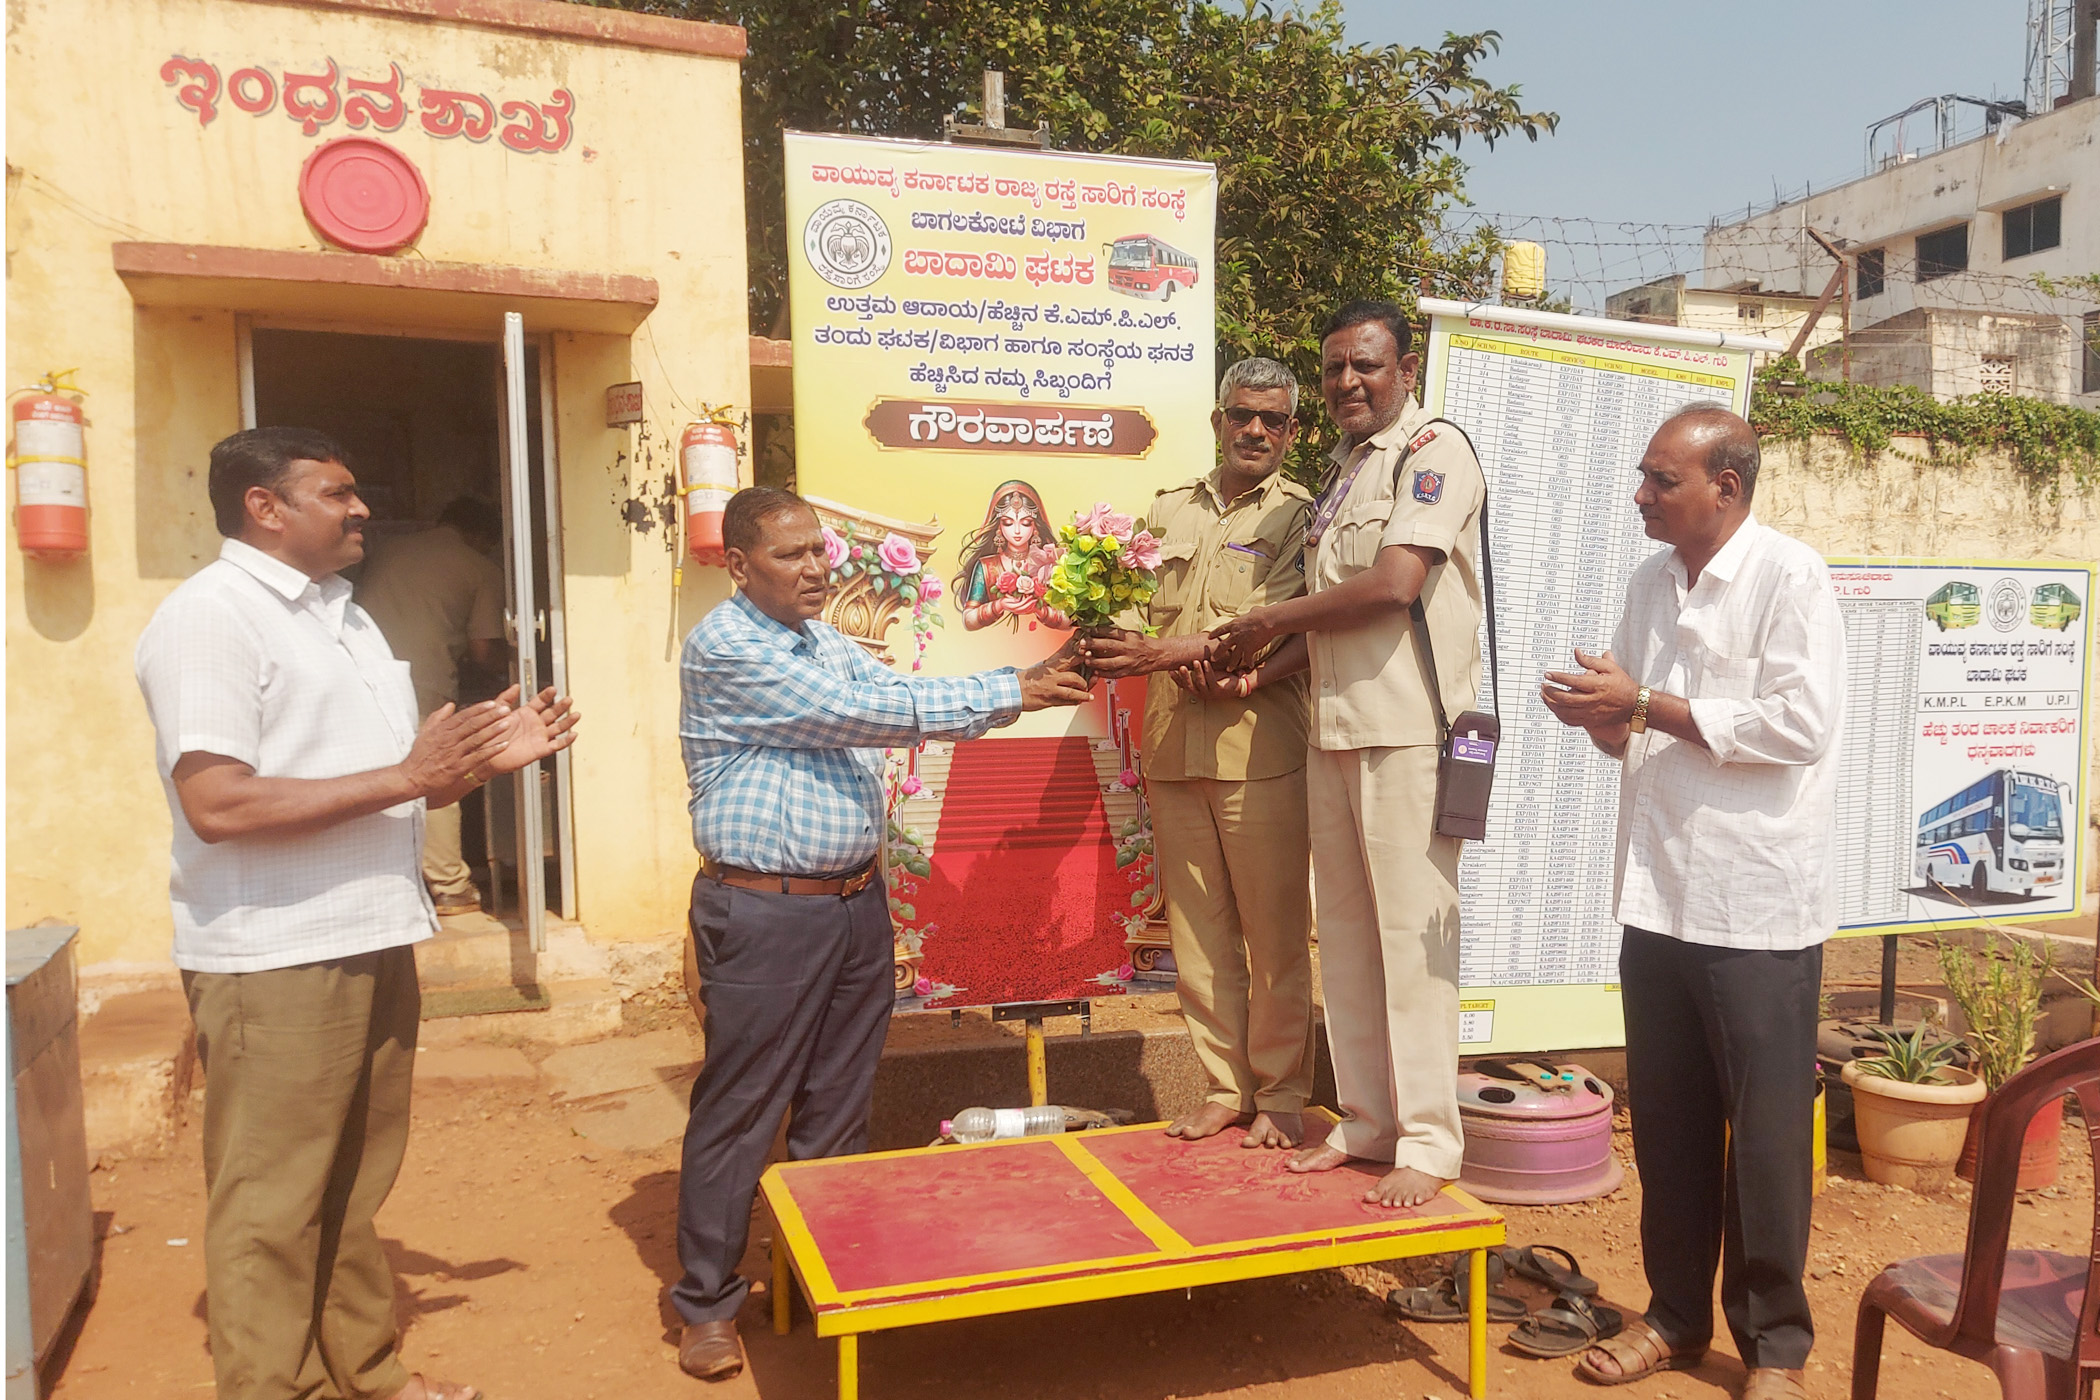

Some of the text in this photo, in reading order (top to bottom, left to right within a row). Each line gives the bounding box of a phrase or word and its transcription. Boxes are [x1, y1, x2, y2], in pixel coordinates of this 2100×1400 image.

[160, 55, 574, 153] ಇಂಧನ ಶಾಖೆ
[812, 163, 1186, 222] ವಾಯುವ್ಯ ಕರ್ನಾಟಕ ರಾಜ್ಯ ರಸ್ತೆ ಸಾರಿಗೆ ಸಂಸ್ಥೆ
[911, 209, 1086, 242] ಬಾಗಲಕೋಟೆ ವಿಭಾಗ
[904, 249, 1094, 288] ಬಾದಾಮಿ ಘಟಕ
[827, 294, 896, 320] ಉತ್ತಮ
[903, 299, 1038, 331] ಆದಾಯ/ಹೆಚ್ಚಿನ
[815, 325, 1195, 370] ತಂದು ಘಟಕ/ವಿಭಾಗ ಹಾಗೂ ಸಂಸ್ಥೆಯ ಘನತೆ
[1540, 328, 1572, 342] ಬಾದಾಮಿ
[1577, 334, 1604, 347] ಘಟಕದ
[1713, 356, 1728, 367] ಗುರಿ
[909, 362, 1112, 398] ಹೆಚ್ಚಿಸಿದ ನಮ್ಮ ಸಿಬ್ಬಂದಿಗೆ
[908, 405, 1114, 447] ಗೌರವಾರ್ಪಣೆ
[1853, 586, 1871, 595] ಗುರಿ
[1928, 641, 1967, 664] ವಾಯುವ್ಯ
[1969, 640, 2008, 656] ಕರ್ನಾಟಕ
[1966, 667, 2027, 684] ಬಾದಾಮಿ ಘಟಕ
[1924, 695, 2070, 708] K.M.P.L E.P.K.M U.P.I
[1922, 722, 1949, 746] ಹೆಚ್ಚು
[1951, 722, 1980, 736] ತಂದ
[1983, 721, 2017, 735] ಚಾಲಕ
[1968, 743, 2036, 765] ಧನ್ಯವಾದಗಳು
